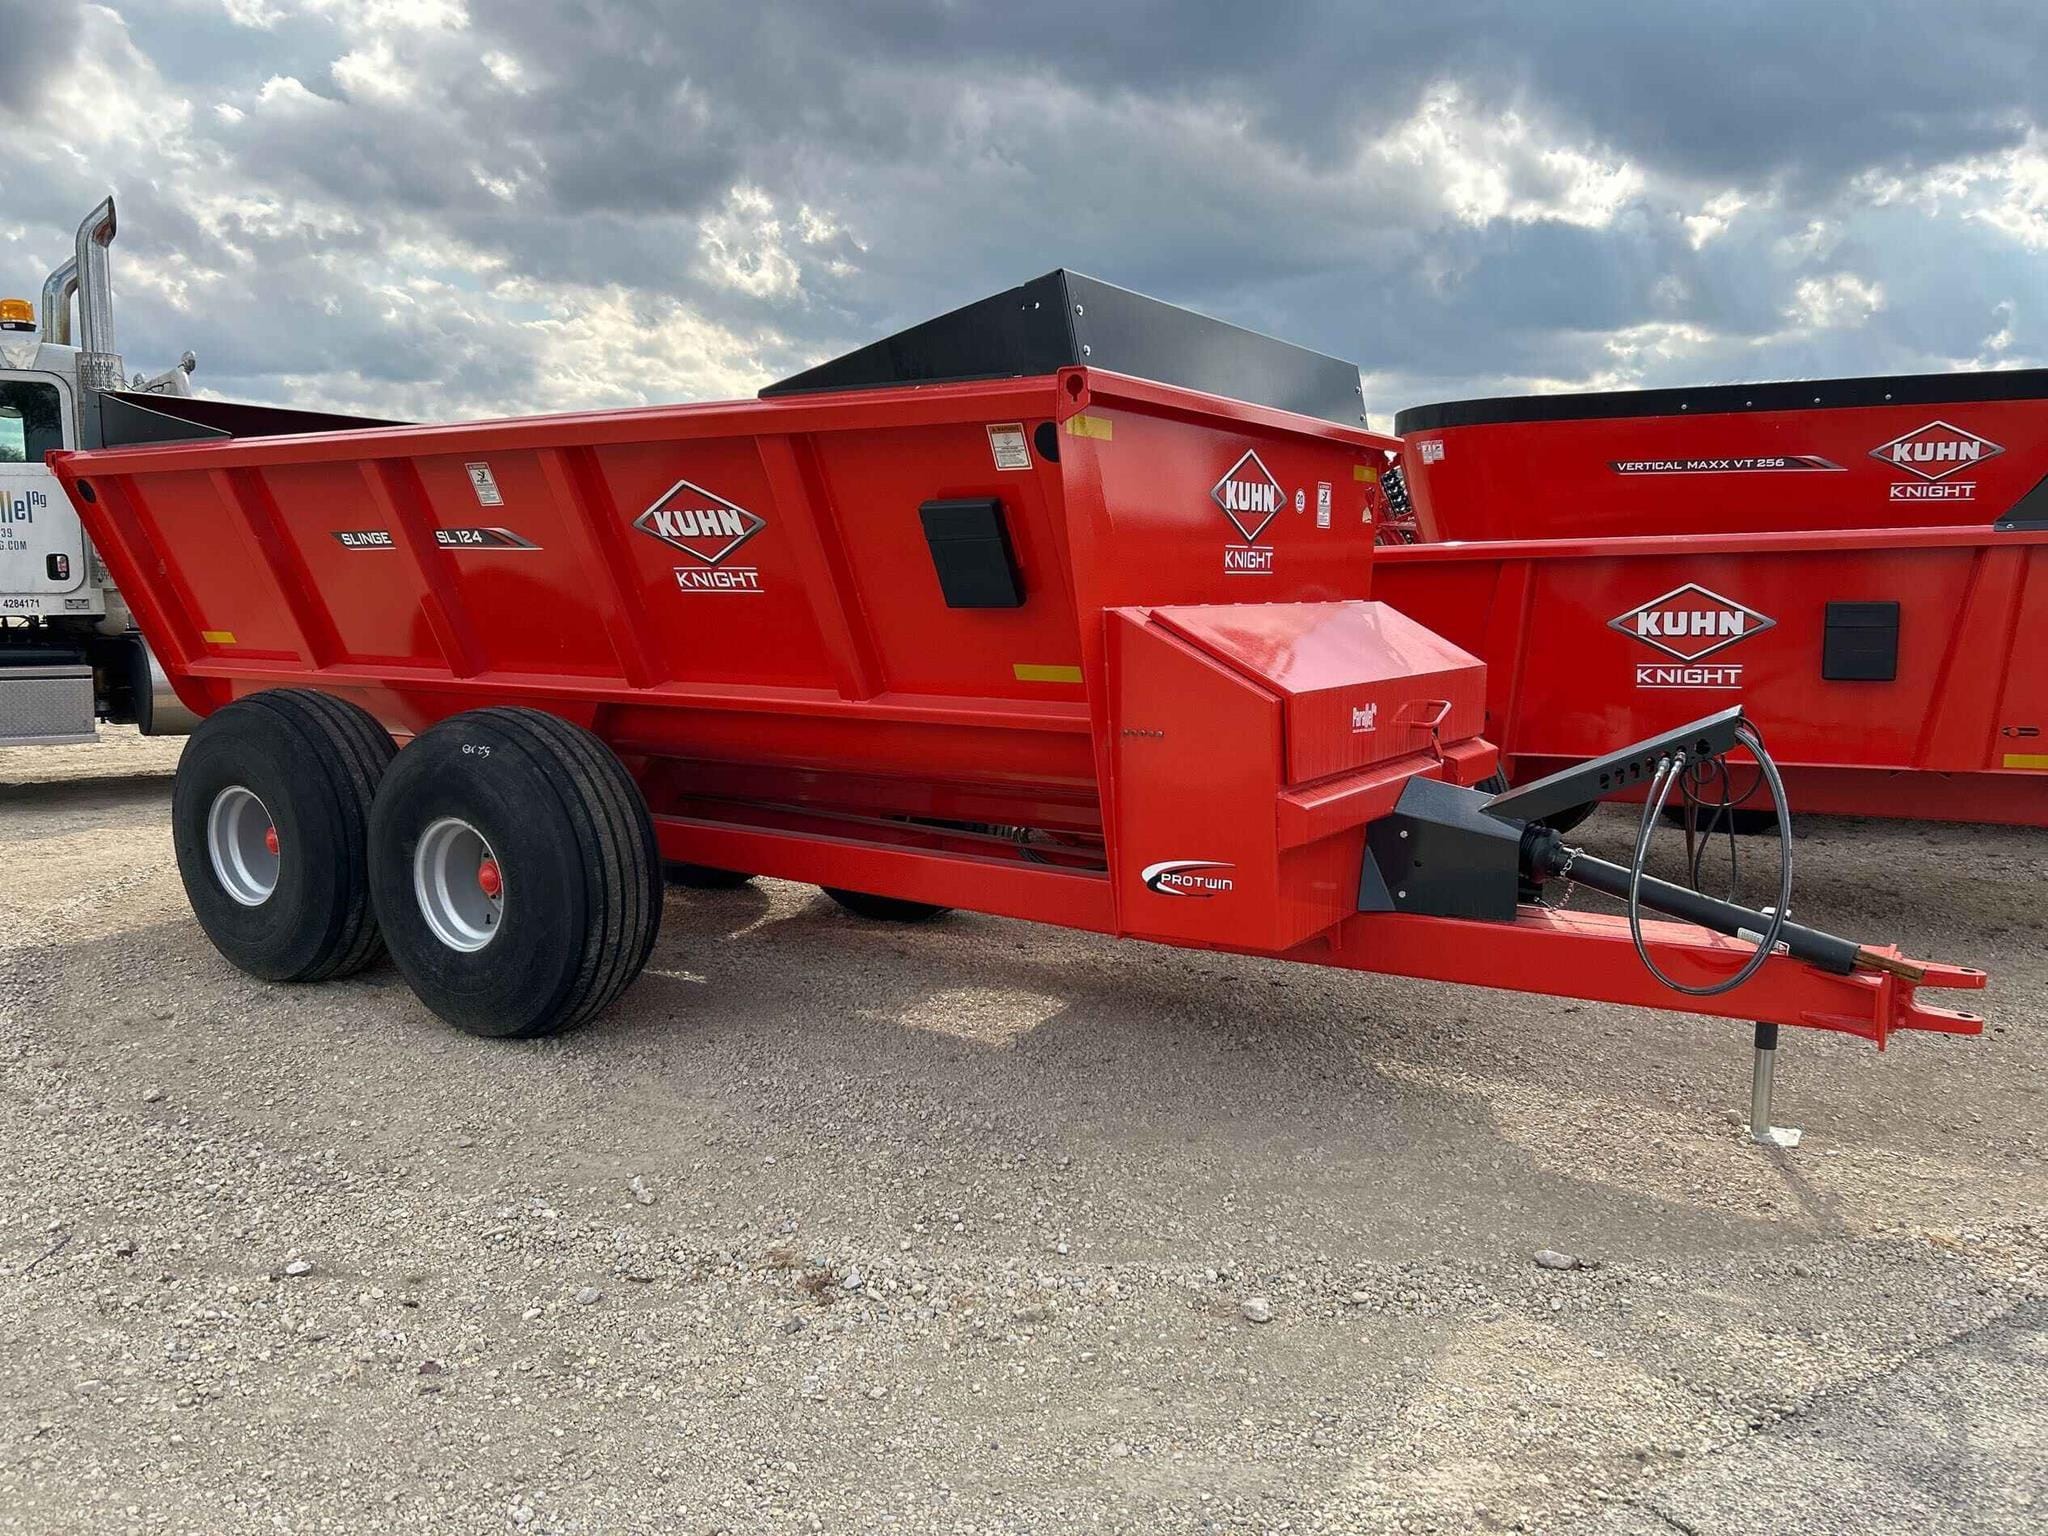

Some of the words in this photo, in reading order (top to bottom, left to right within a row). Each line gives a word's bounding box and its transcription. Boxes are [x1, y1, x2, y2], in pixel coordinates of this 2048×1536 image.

[1893, 442, 1980, 462] KUHN
[1617, 462, 1682, 471] VERTICAL
[1687, 460, 1729, 470] MAXX
[1733, 459, 1753, 468] VT
[1756, 458, 1785, 467] 256
[1225, 480, 1275, 512] KUHN
[1890, 485, 1977, 497] KNIGHT
[653, 509, 745, 537] KUHN
[341, 532, 392, 545] SLINGE
[435, 531, 456, 543] SL
[456, 530, 483, 543] 124
[1225, 550, 1273, 569] KNIGHT
[675, 572, 759, 588] KNIGHT
[3, 599, 40, 609] 4284171
[1637, 611, 1744, 636] KUHN
[1636, 669, 1742, 684] KNIGHT
